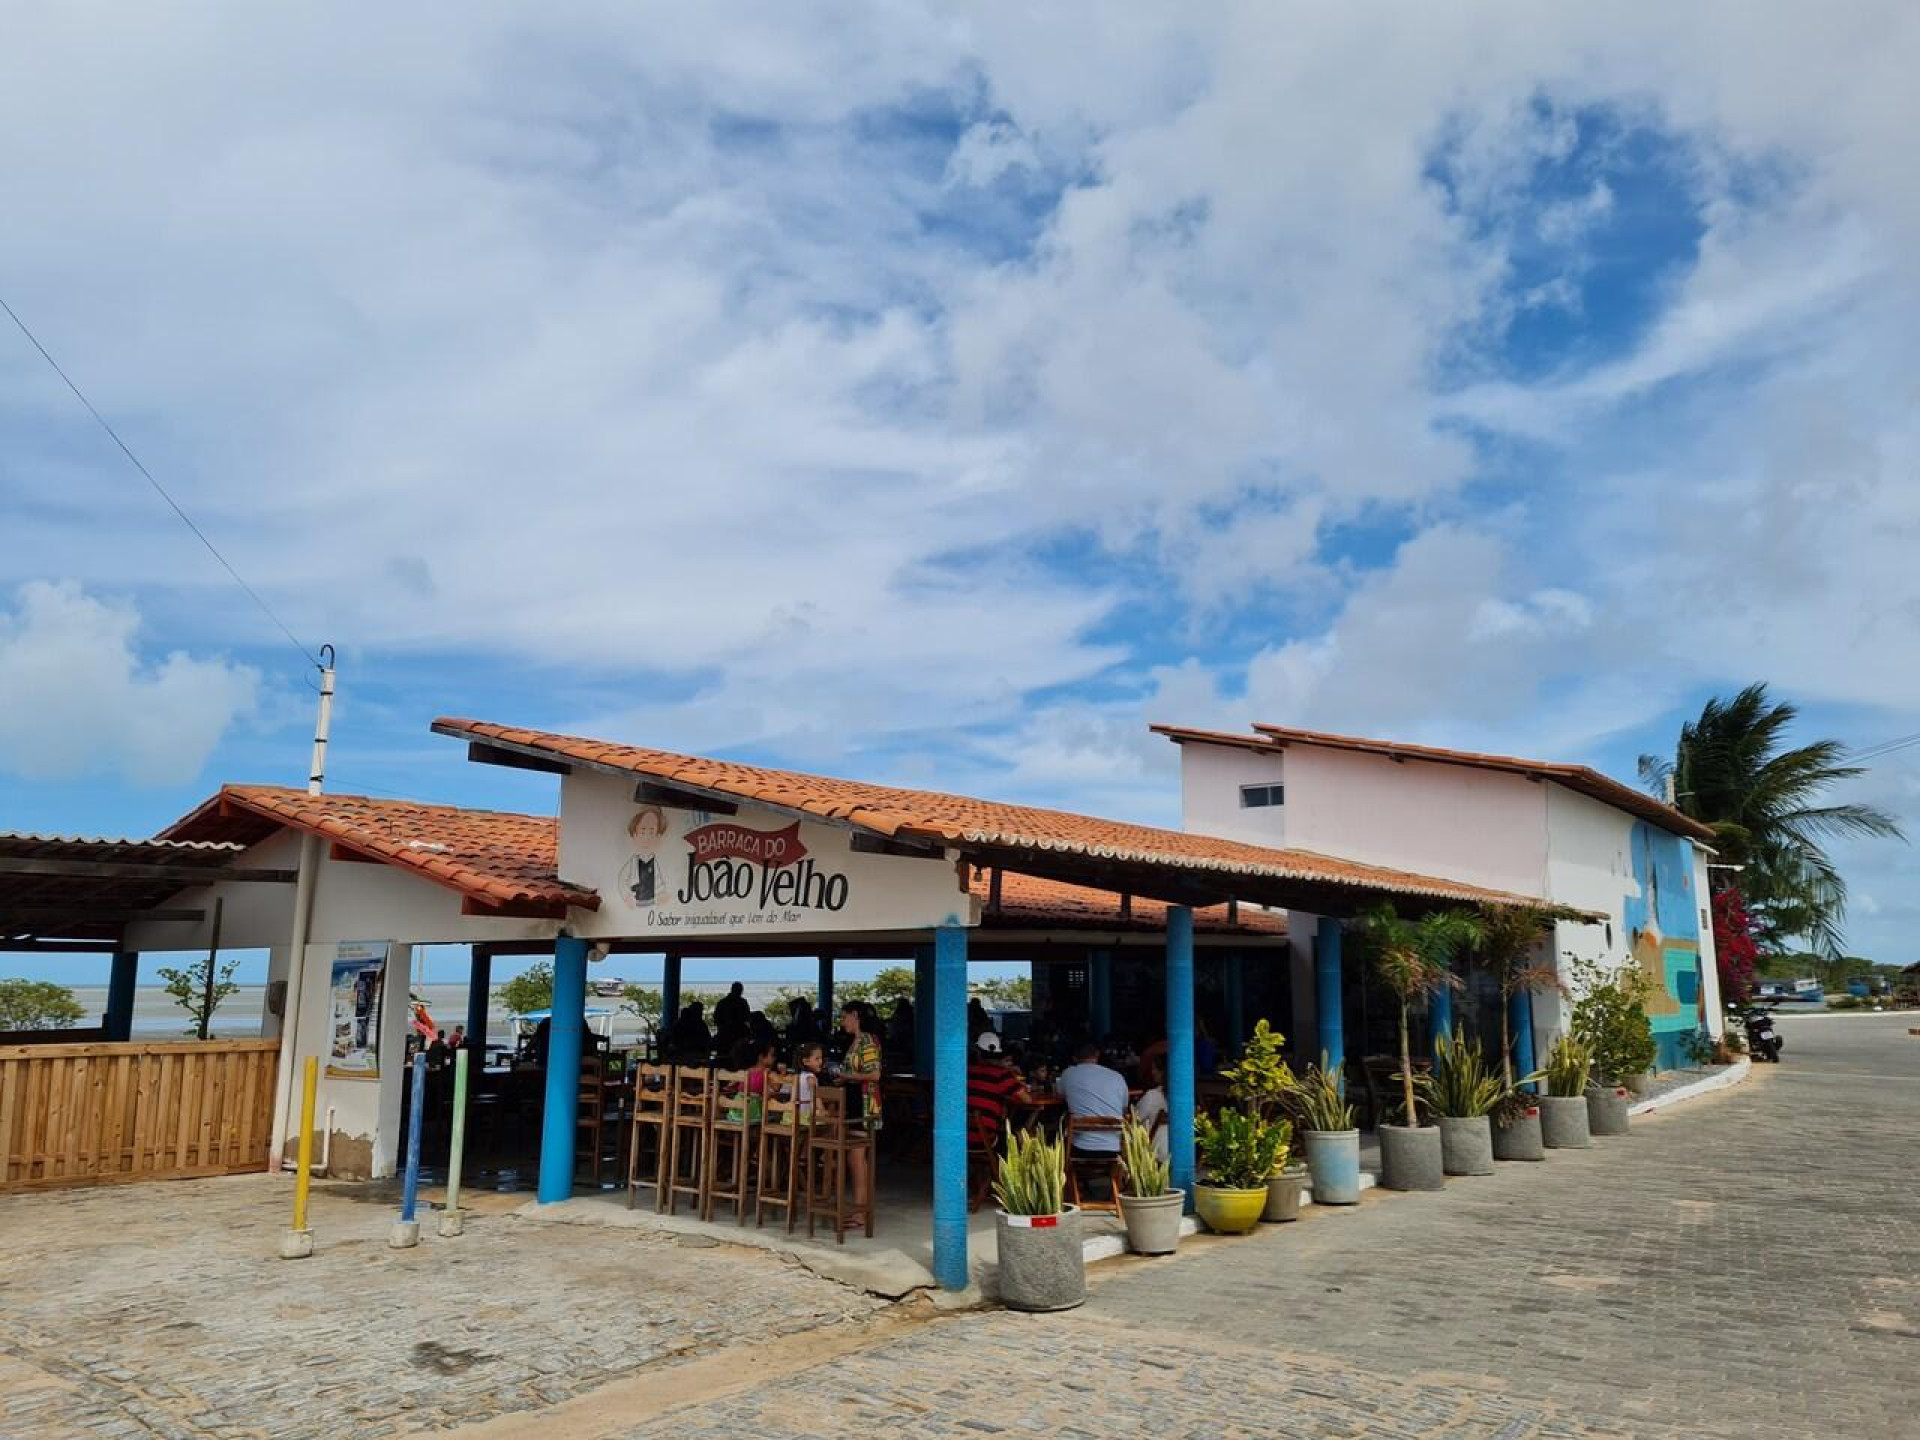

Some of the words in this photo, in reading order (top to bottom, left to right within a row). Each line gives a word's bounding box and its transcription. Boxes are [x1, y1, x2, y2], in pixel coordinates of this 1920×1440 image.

[697, 830, 760, 856] BARRACA
[765, 838, 786, 858] DO
[759, 858, 848, 911] Velho
[648, 910, 655, 926] O
[657, 911, 681, 926] Sabor
